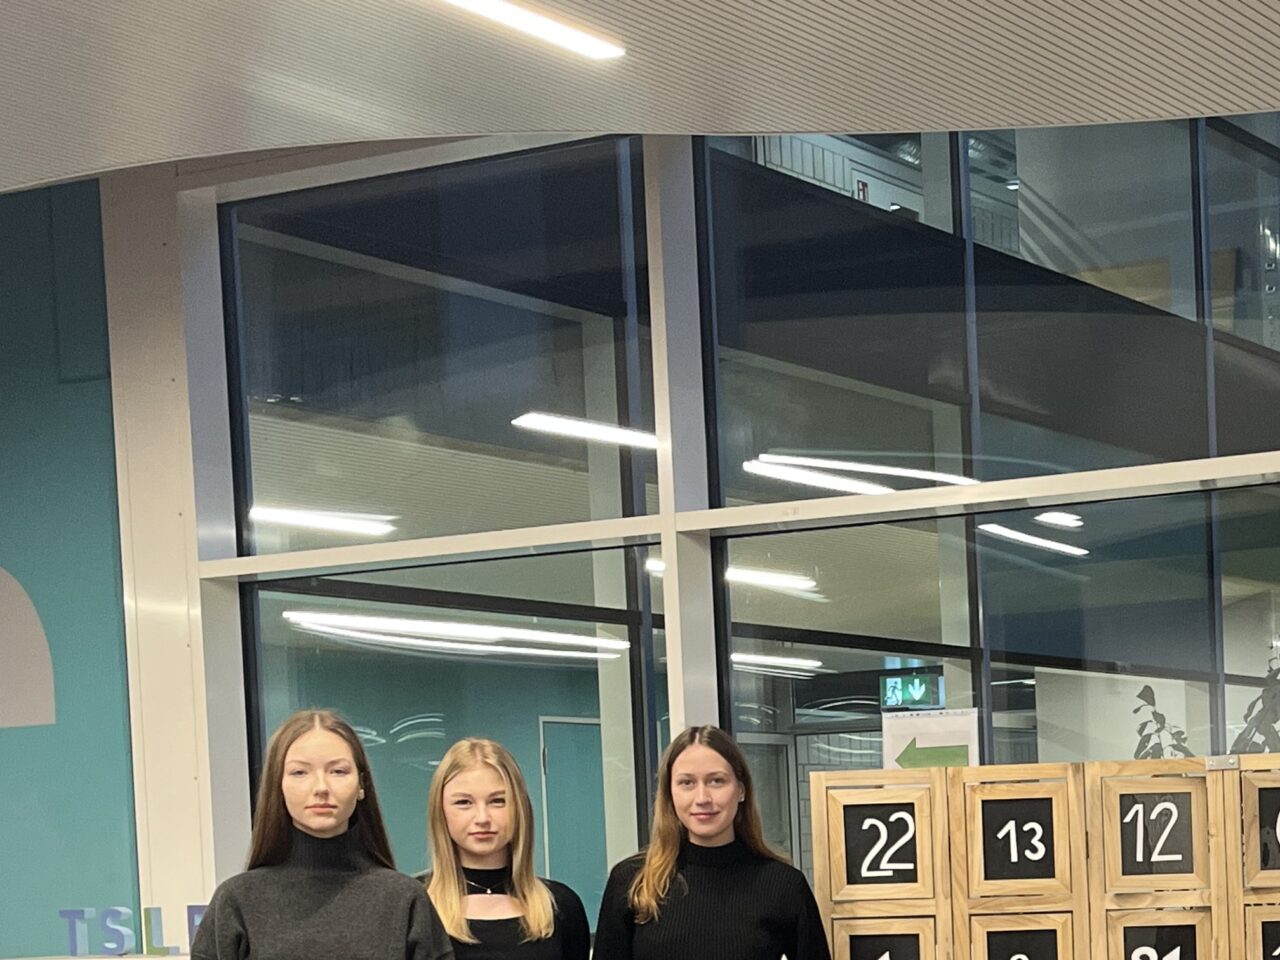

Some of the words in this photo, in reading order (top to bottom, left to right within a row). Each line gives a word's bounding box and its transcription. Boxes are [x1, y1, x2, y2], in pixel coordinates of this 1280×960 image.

[859, 810, 917, 879] 22
[996, 819, 1046, 863] 13
[1121, 799, 1184, 865] 12
